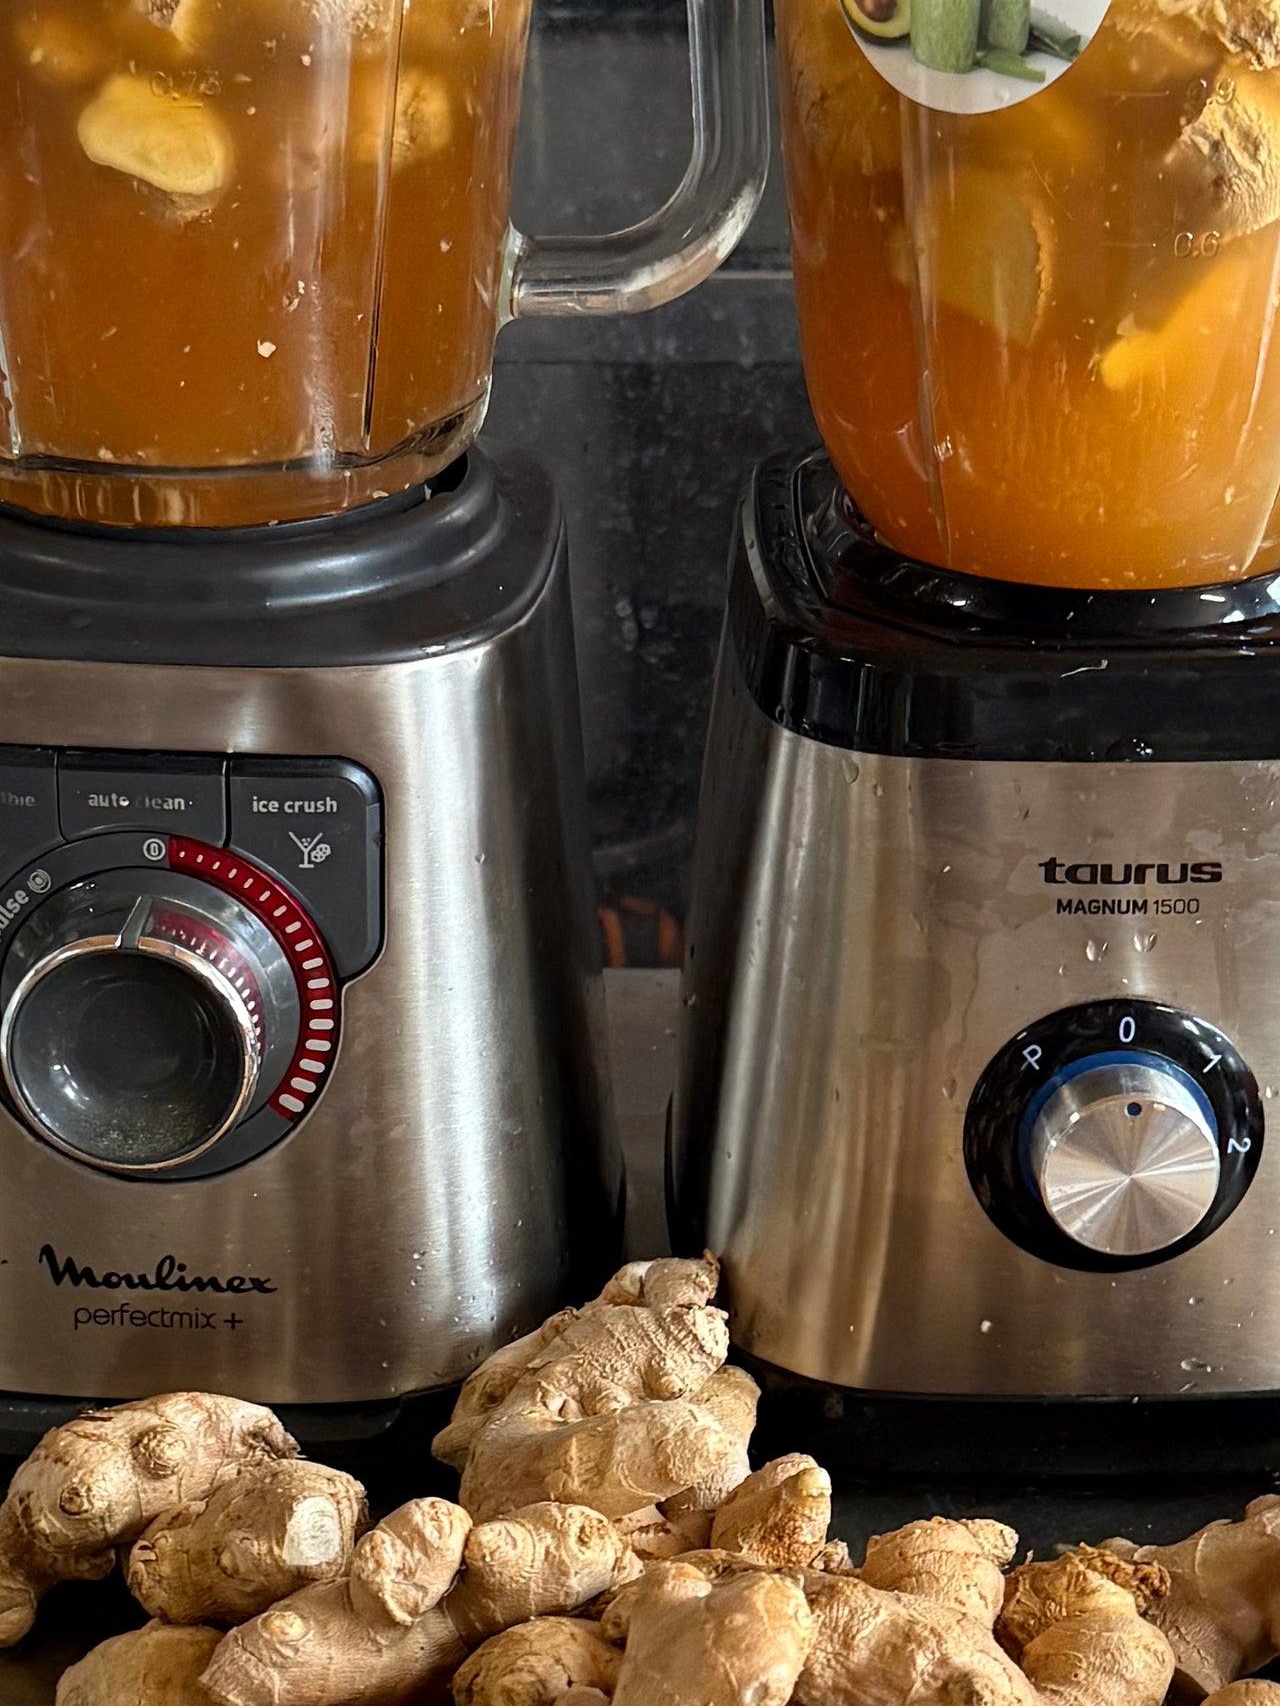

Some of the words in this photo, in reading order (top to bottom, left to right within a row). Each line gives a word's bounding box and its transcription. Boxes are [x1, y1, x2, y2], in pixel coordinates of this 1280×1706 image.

[1175, 230, 1220, 258] 0.6
[252, 796, 279, 813] ice
[284, 797, 337, 814] crush
[1038, 857, 1223, 885] taurus
[1056, 899, 1148, 915] MAGNUM
[1153, 898, 1200, 915] 1500
[1119, 1017, 1136, 1043] 0
[1022, 1044, 1043, 1070] P
[1227, 1137, 1251, 1154] 2
[39, 1244, 278, 1293] Moulinex
[74, 1303, 217, 1330] perfectmix
